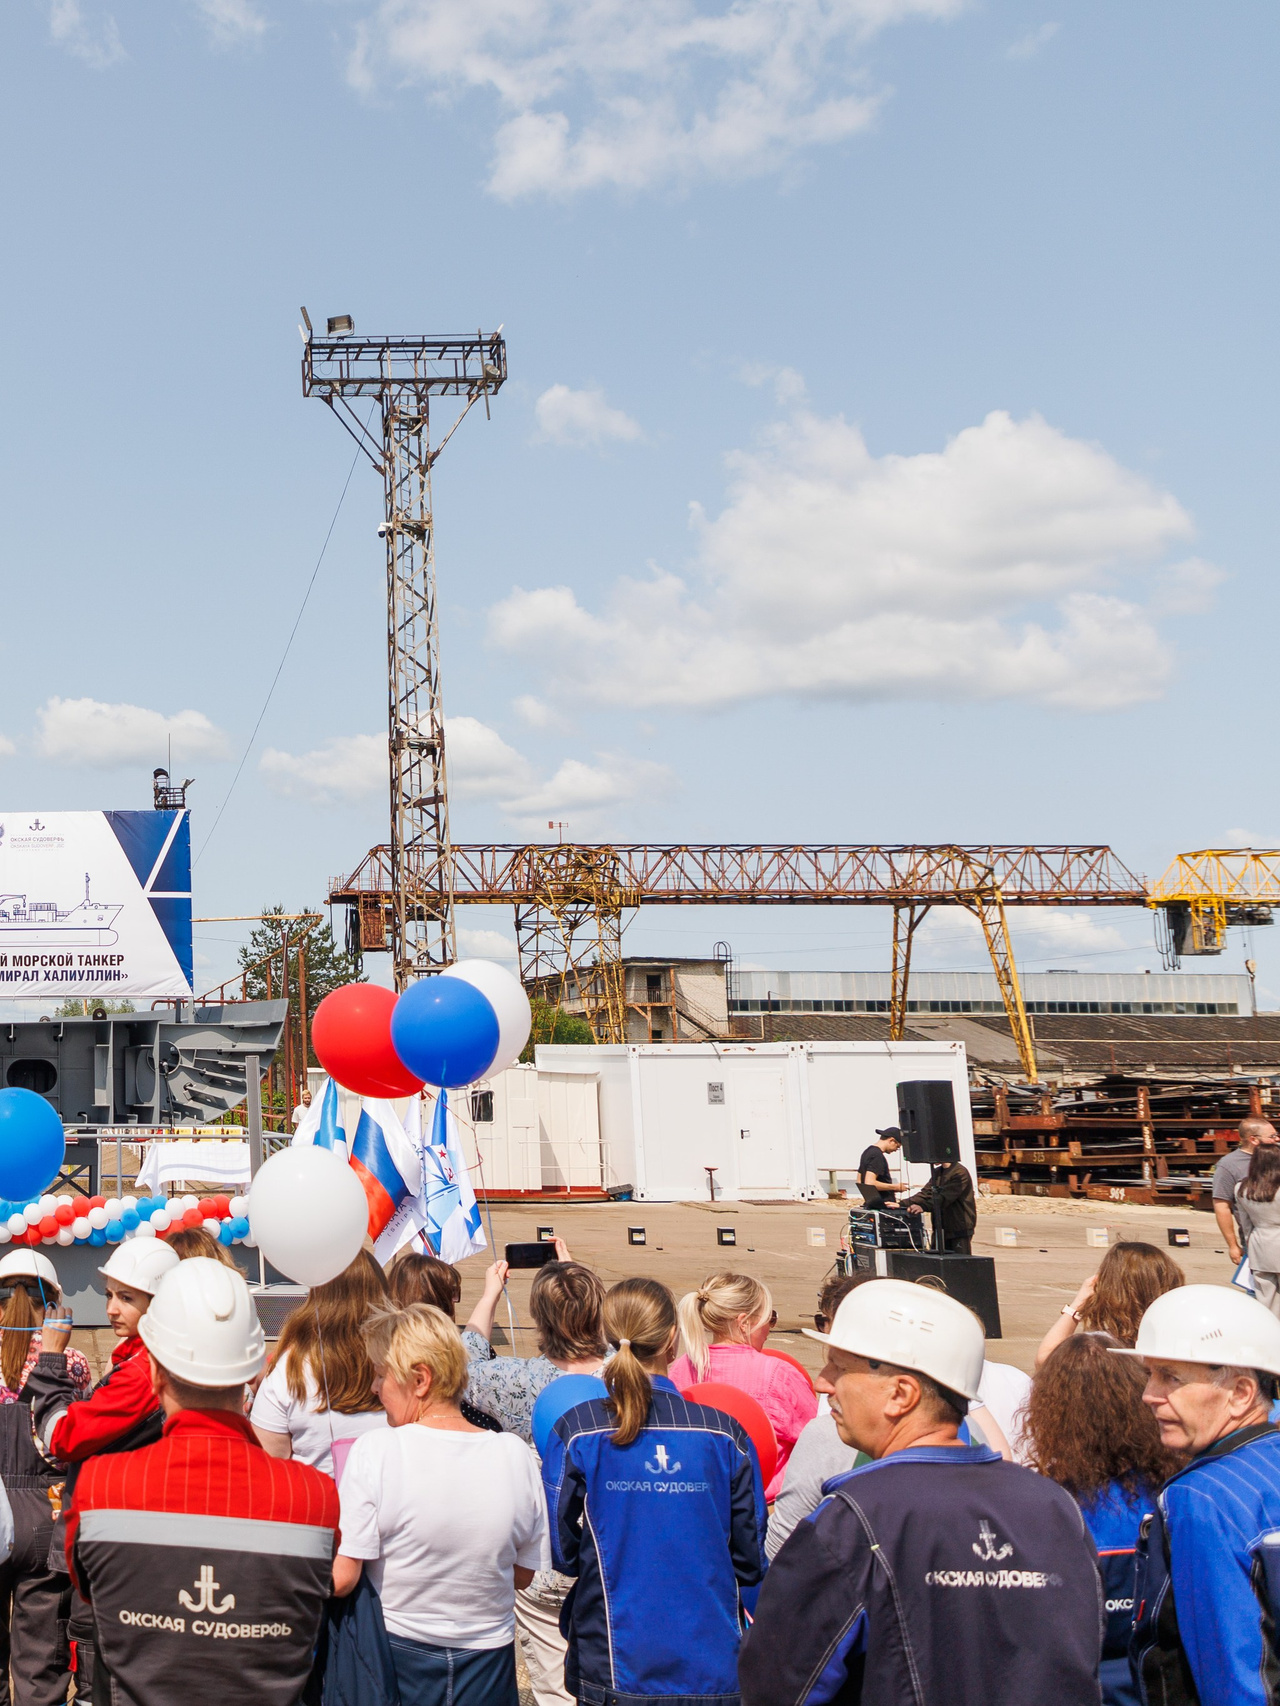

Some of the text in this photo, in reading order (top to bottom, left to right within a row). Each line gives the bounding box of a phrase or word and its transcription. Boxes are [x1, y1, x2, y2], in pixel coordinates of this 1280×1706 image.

[12, 952, 73, 967] МОРСКОЙ
[77, 954, 124, 966] ТАНКЕР
[43, 969, 128, 982] ХАЛИУЛЛИН»
[606, 1480, 710, 1494] ОКСКАЯ СУДОВЕР
[925, 1570, 984, 1587] ОКСКАЯ
[1105, 1598, 1134, 1611] ОКС
[119, 1610, 292, 1640] ОКСКАЯ СУДОВЕРФЬ
